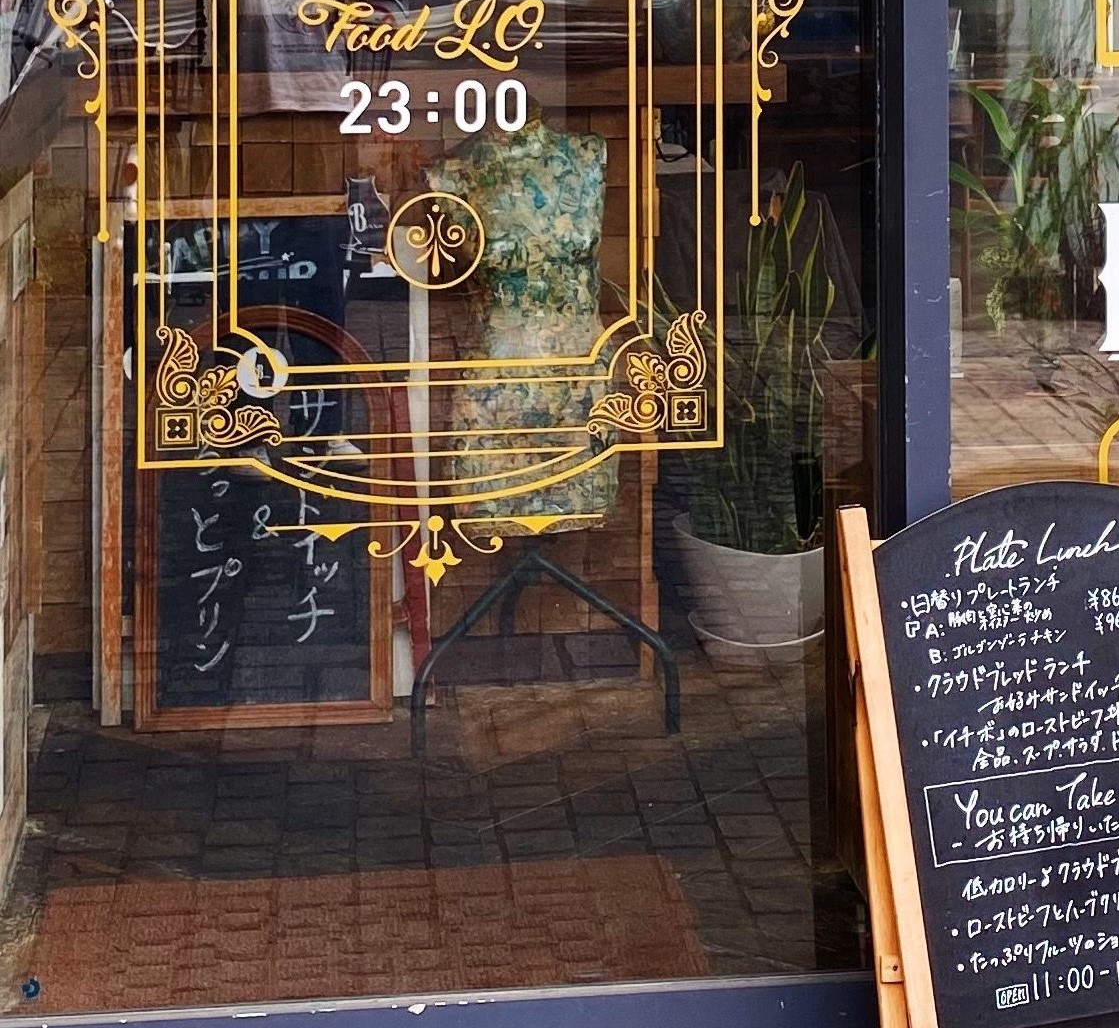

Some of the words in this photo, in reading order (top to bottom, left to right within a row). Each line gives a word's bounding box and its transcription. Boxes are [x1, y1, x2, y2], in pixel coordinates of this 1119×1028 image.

[339, 78, 529, 135] 23:00
[953, 528, 1028, 577] Plate
[954, 789, 1005, 830] You
[1009, 801, 1052, 824] can
[1056, 771, 1117, 811] Take
